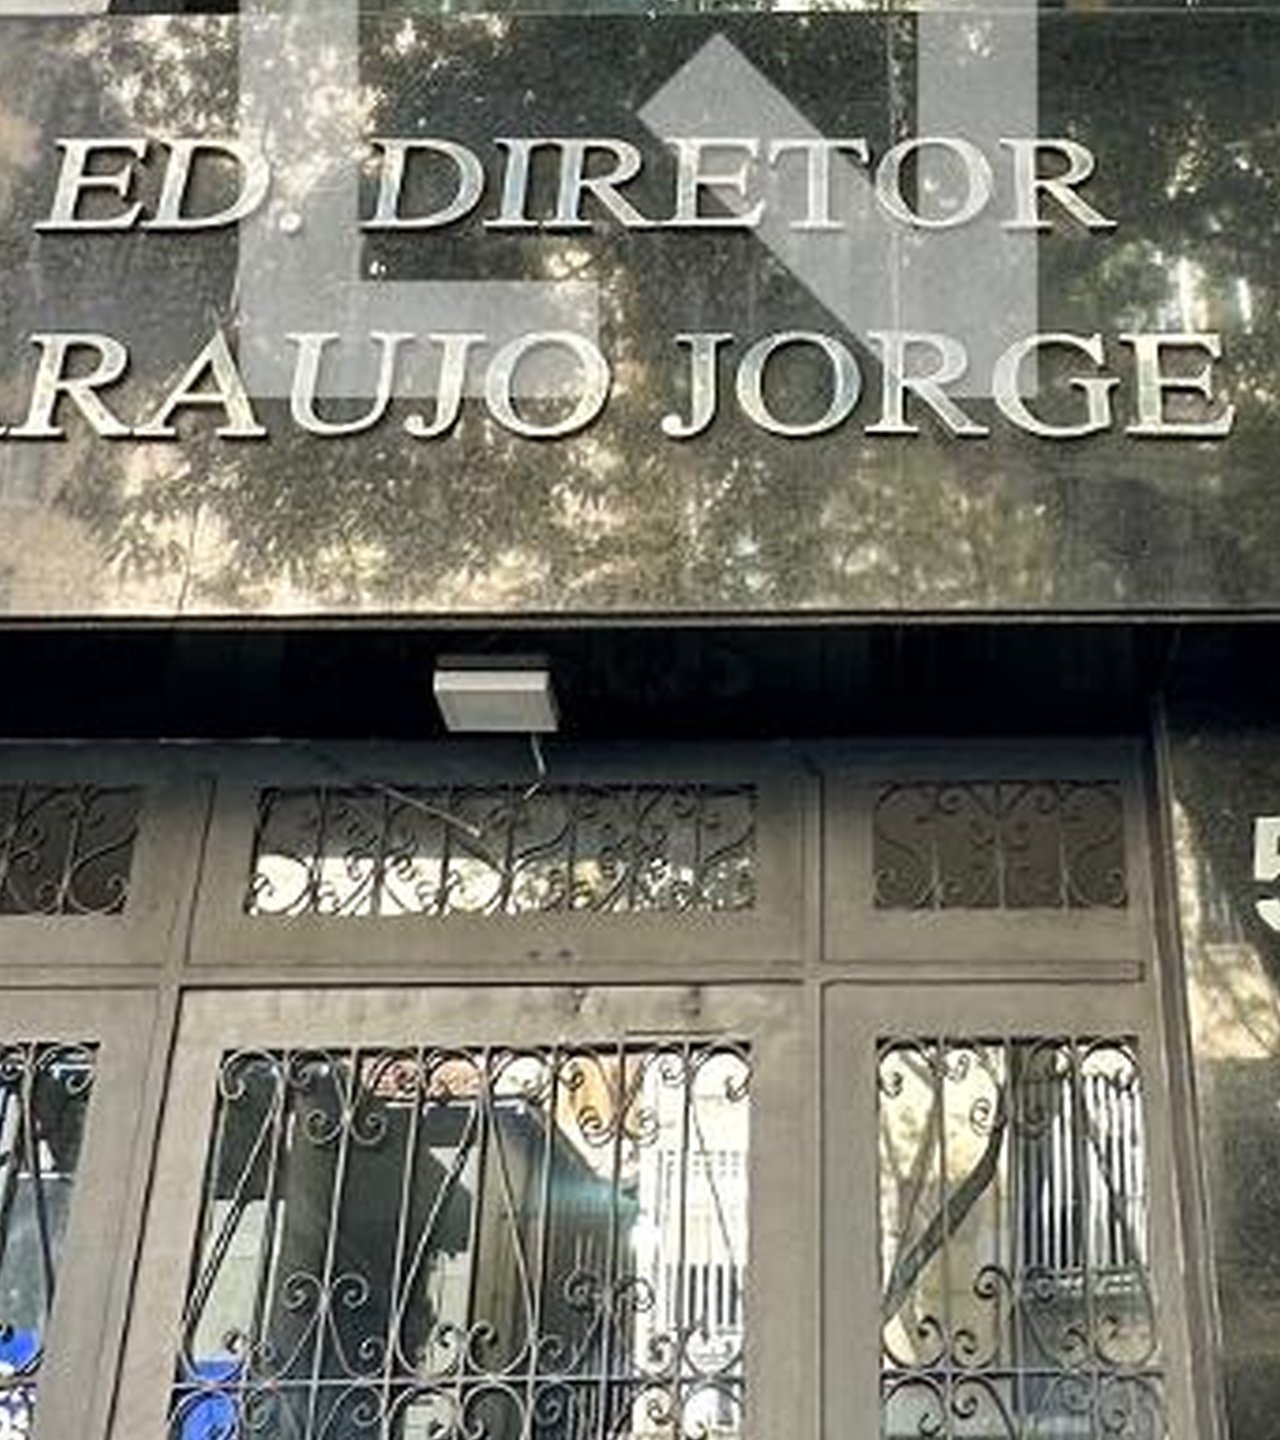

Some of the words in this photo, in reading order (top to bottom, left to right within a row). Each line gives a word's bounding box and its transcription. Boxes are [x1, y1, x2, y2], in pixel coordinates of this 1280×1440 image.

[33, 137, 302, 233] ED.
[360, 137, 1118, 233] DIRETOR
[661, 331, 1234, 439] JORGE
